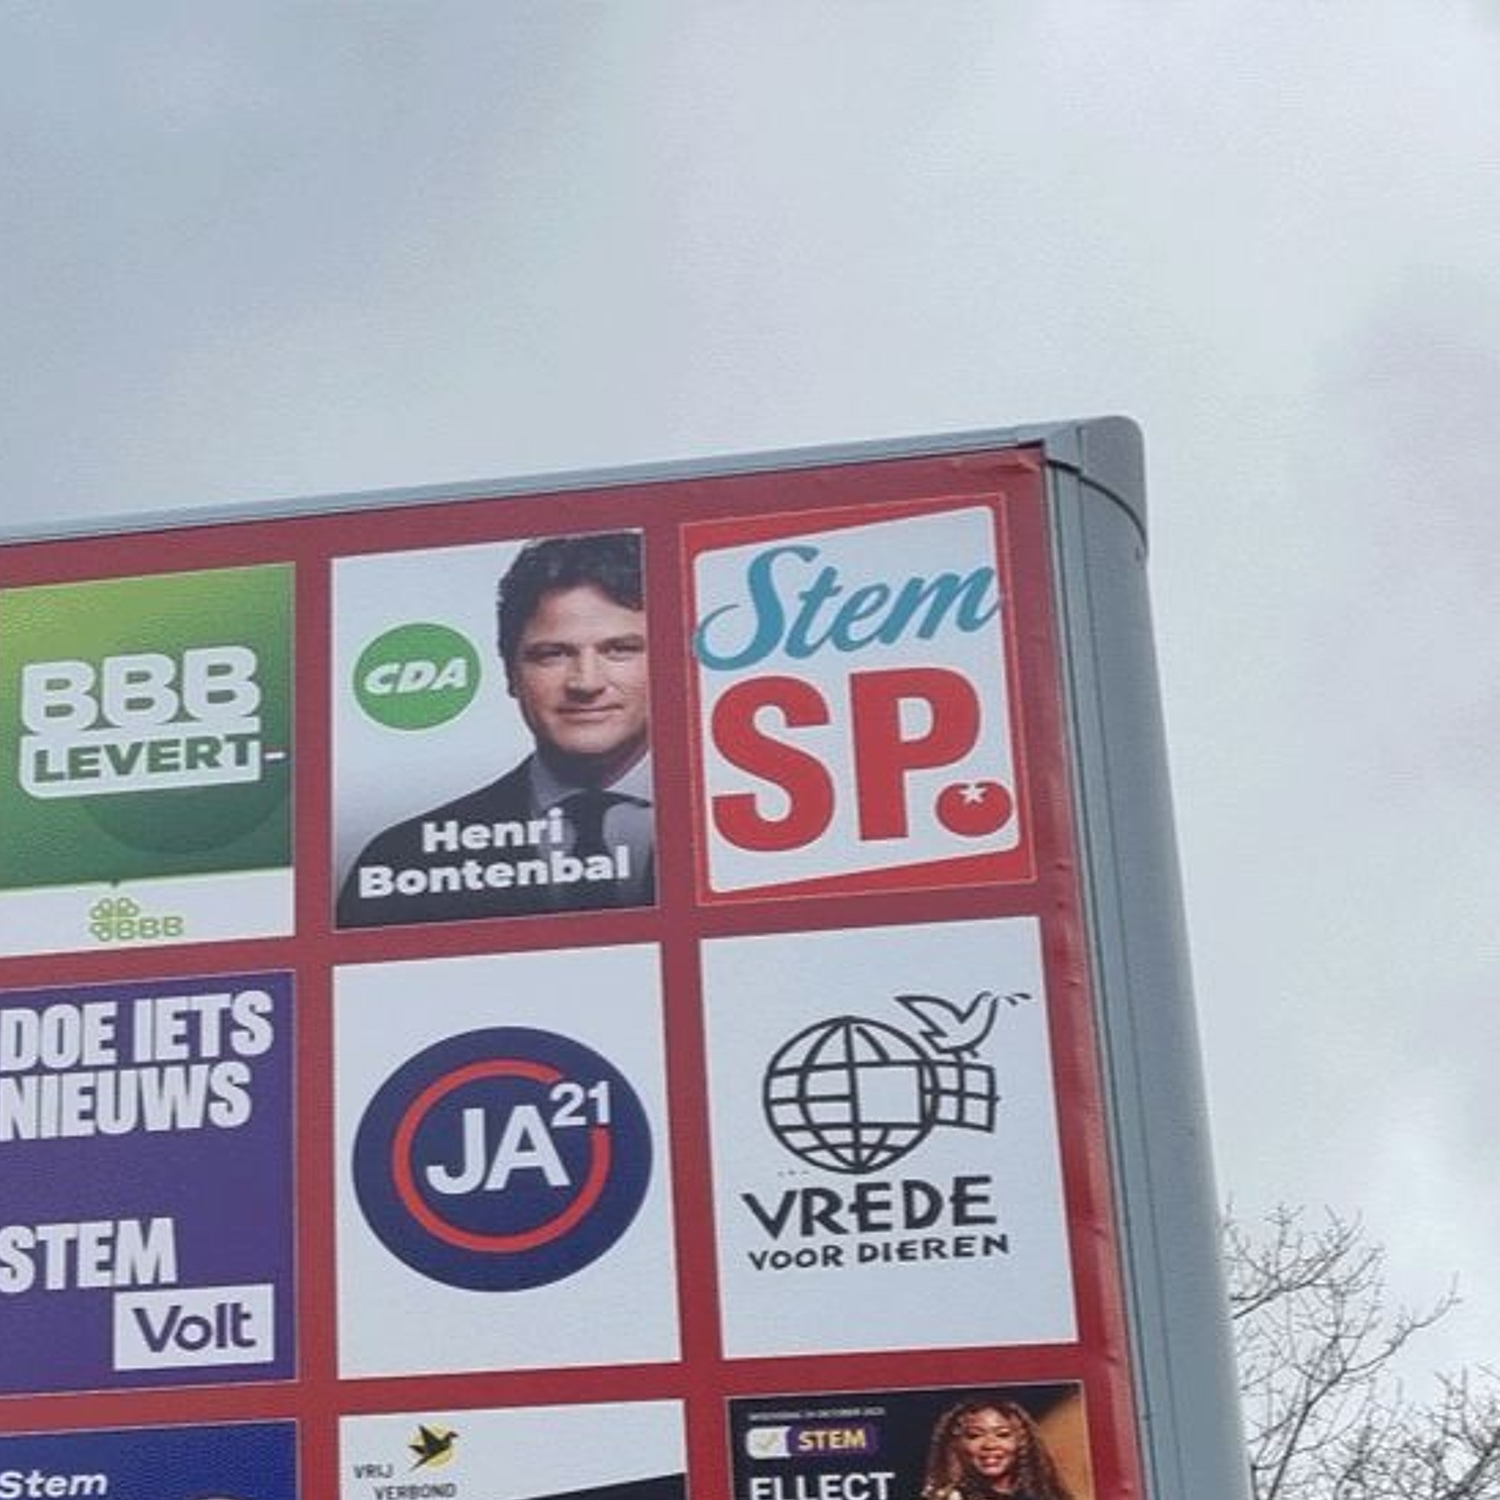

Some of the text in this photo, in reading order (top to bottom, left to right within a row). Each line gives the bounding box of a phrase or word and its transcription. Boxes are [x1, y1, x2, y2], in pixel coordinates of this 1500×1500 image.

[694, 545, 999, 672] Stem
[18, 644, 262, 736] BBB
[362, 656, 471, 696] CDA
[420, 808, 566, 856] Henri
[357, 847, 631, 900] Bontenbal
[133, 989, 275, 1060] IETS
[740, 1175, 999, 1240] VREDE
[748, 1233, 1010, 1272] VOOR DIEREN
[133, 1301, 257, 1353] Volt
[797, 1429, 866, 1450] STEM
[353, 1464, 394, 1480] VRIJ
